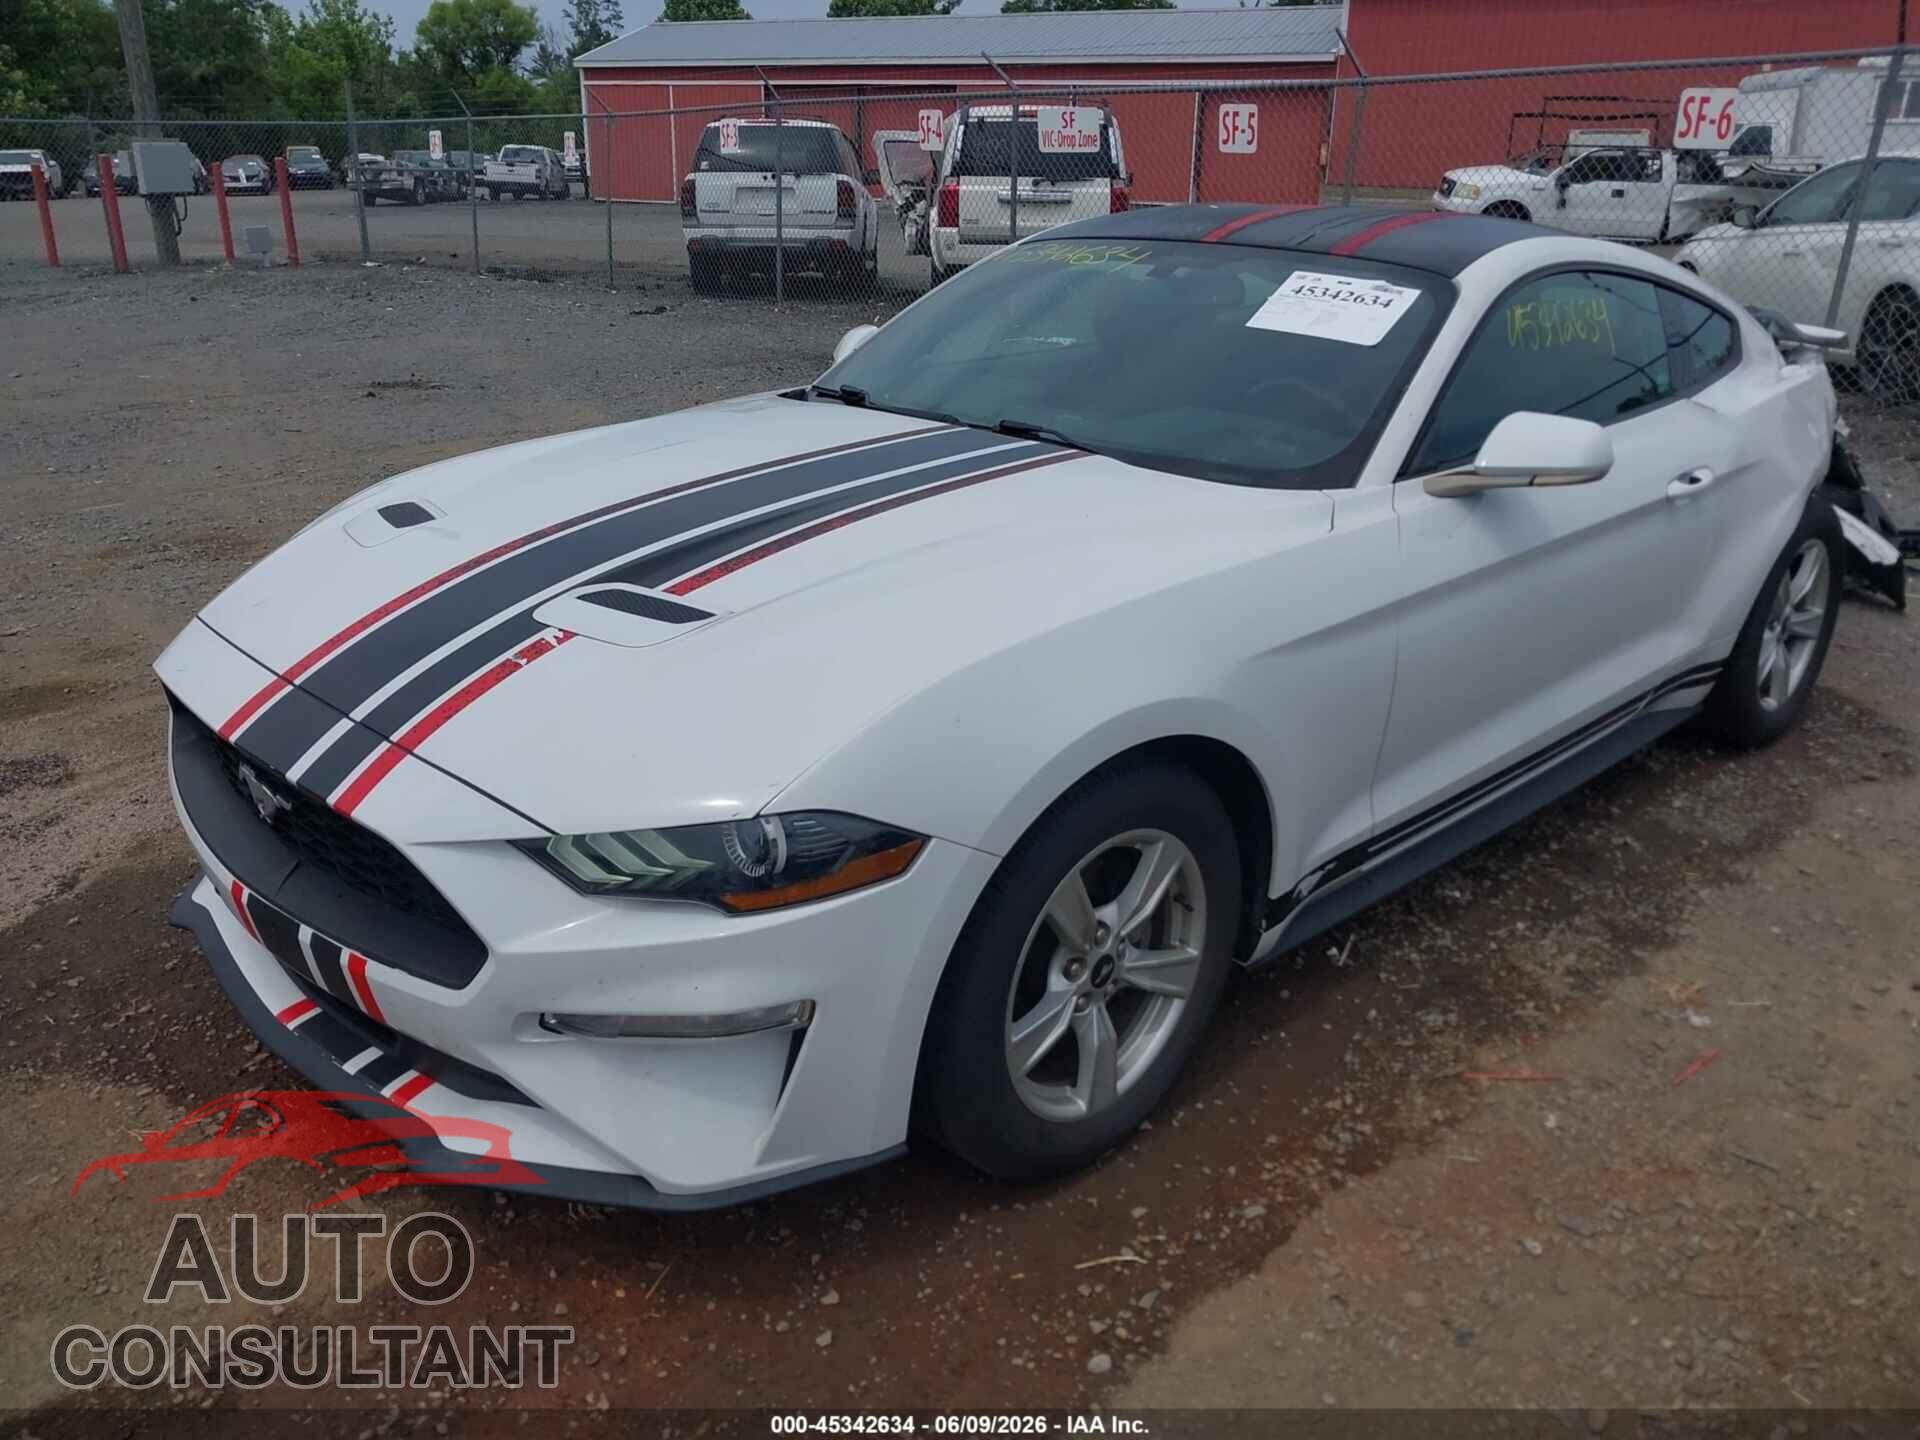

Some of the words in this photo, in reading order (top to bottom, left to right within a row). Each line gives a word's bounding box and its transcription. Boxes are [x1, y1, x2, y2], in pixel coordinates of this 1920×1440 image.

[919, 115, 943, 145] SF-4
[1060, 111, 1076, 129] SF
[1221, 110, 1256, 146] SF-5
[1678, 95, 1735, 140] SF-6
[1041, 130, 1076, 150] VIC-Drop
[1078, 129, 1098, 148] Zone
[1291, 284, 1395, 309] 45342634
